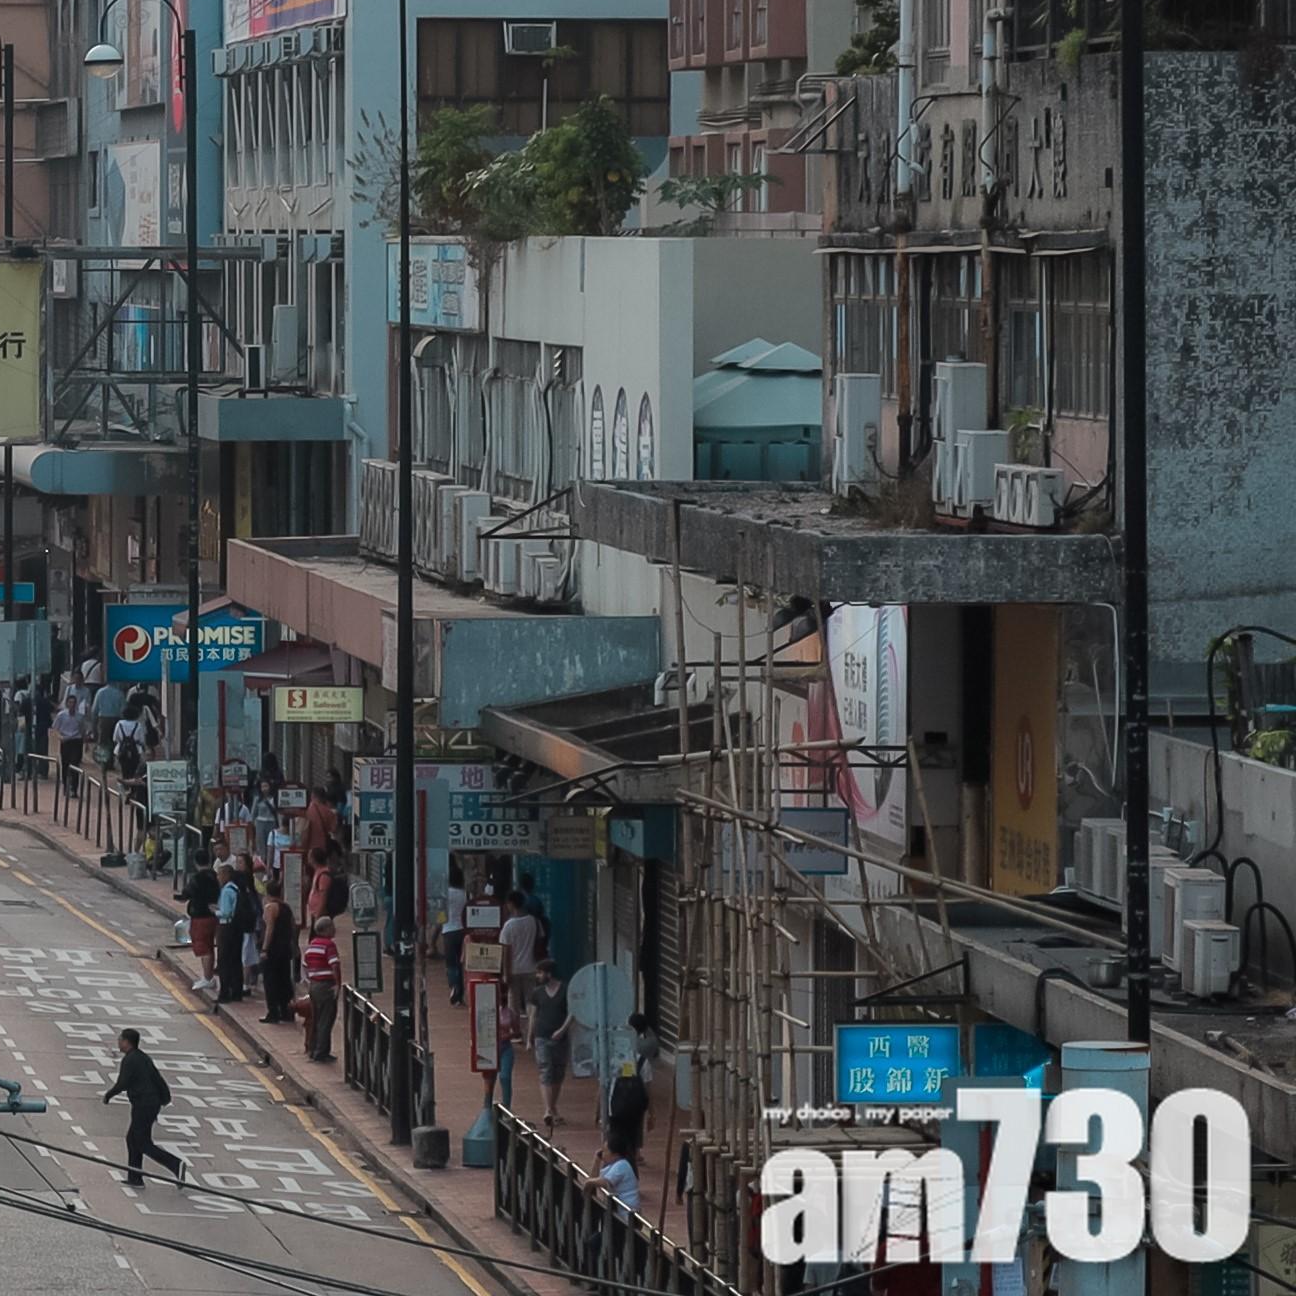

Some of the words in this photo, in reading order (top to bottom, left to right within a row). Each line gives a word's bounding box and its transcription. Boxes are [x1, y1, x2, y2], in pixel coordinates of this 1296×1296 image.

[470, 823, 530, 837] 0083
[2, 965, 151, 988] 巴士
[868, 1035, 930, 1058] 西醫
[848, 1067, 949, 1094] 殷錦新
